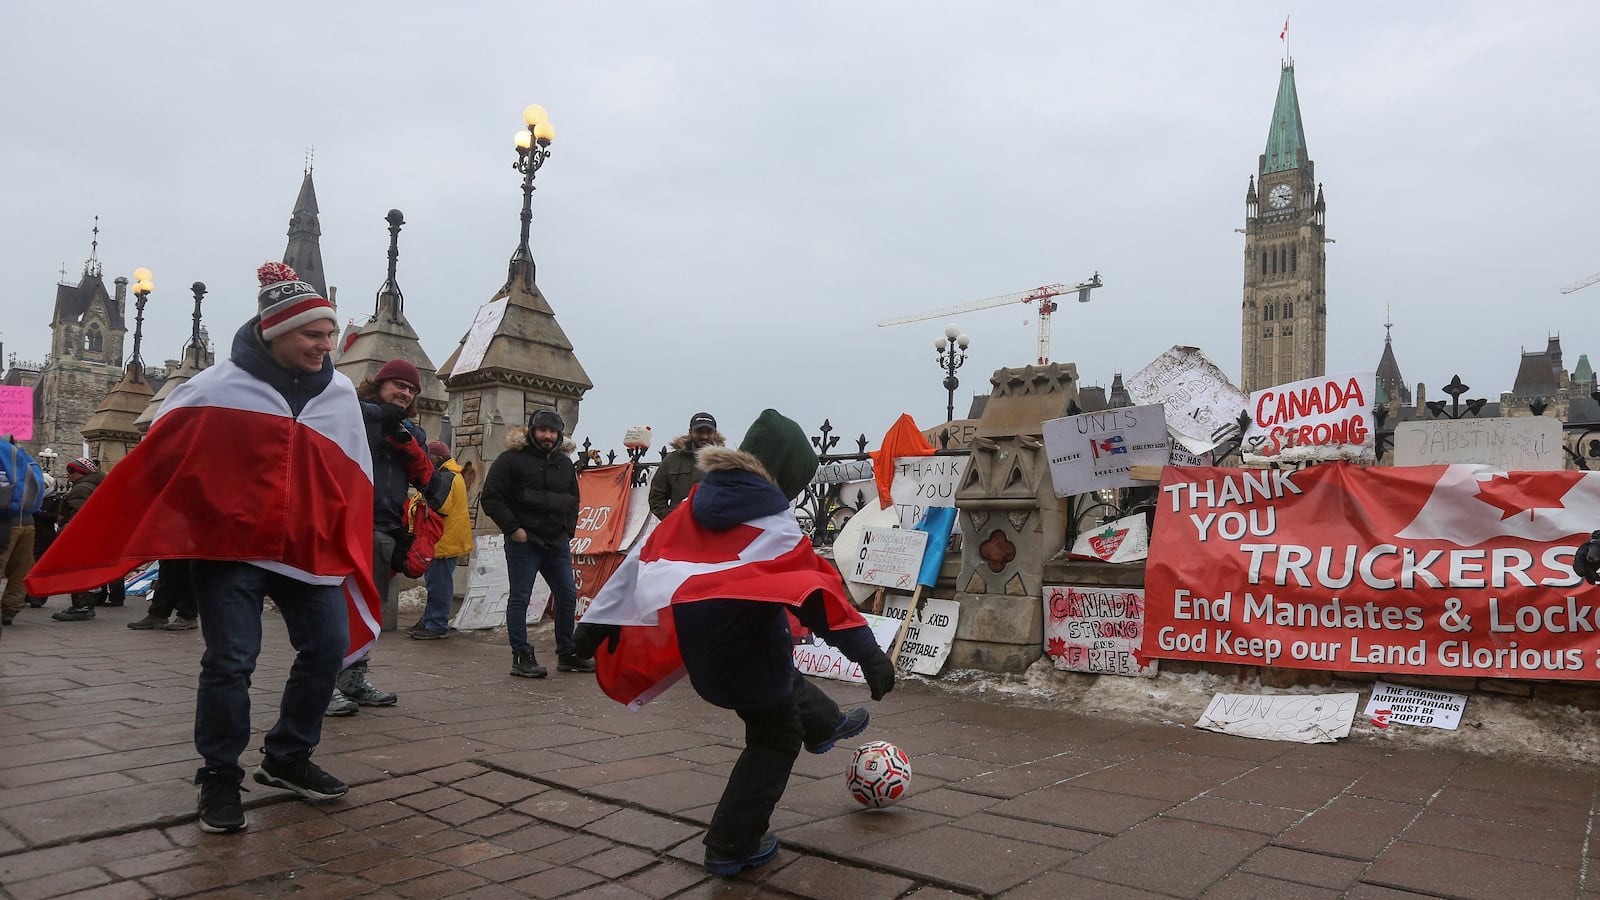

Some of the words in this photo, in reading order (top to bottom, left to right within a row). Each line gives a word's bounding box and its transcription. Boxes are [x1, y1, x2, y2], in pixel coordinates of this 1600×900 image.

[1256, 377, 1365, 428] CANADA
[1076, 410, 1137, 434] UNIS
[928, 425, 975, 449] MRE
[1263, 415, 1368, 457] STRONG
[816, 461, 864, 483] BERTY
[900, 462, 960, 477] THANK
[1187, 456, 1201, 466] HAS
[916, 482, 953, 499] YOU
[1164, 469, 1302, 513] THANK
[1190, 506, 1276, 541] YOU
[1240, 543, 1583, 590] TRUCKERS
[1050, 593, 1140, 619] CANADA
[1174, 589, 1232, 622] End
[1243, 593, 1424, 631] Mandates
[1438, 597, 1472, 632] &
[1068, 620, 1138, 639] STRONG
[1093, 641, 1115, 649] AND
[1158, 627, 1207, 653] God
[1216, 629, 1282, 664] Keep
[1290, 641, 1341, 662] our
[1350, 637, 1426, 666] Land
[1437, 641, 1584, 670] Glorious
[1069, 647, 1129, 673] FREE
[1373, 695, 1460, 712] AUTHORITARIANS
[1386, 686, 1404, 696] THE
[1406, 689, 1453, 702] CORRUPT
[1210, 697, 1274, 718] NON
[1276, 698, 1352, 721] CODE
[1391, 705, 1420, 713] MUST
[1421, 707, 1437, 716] BE
